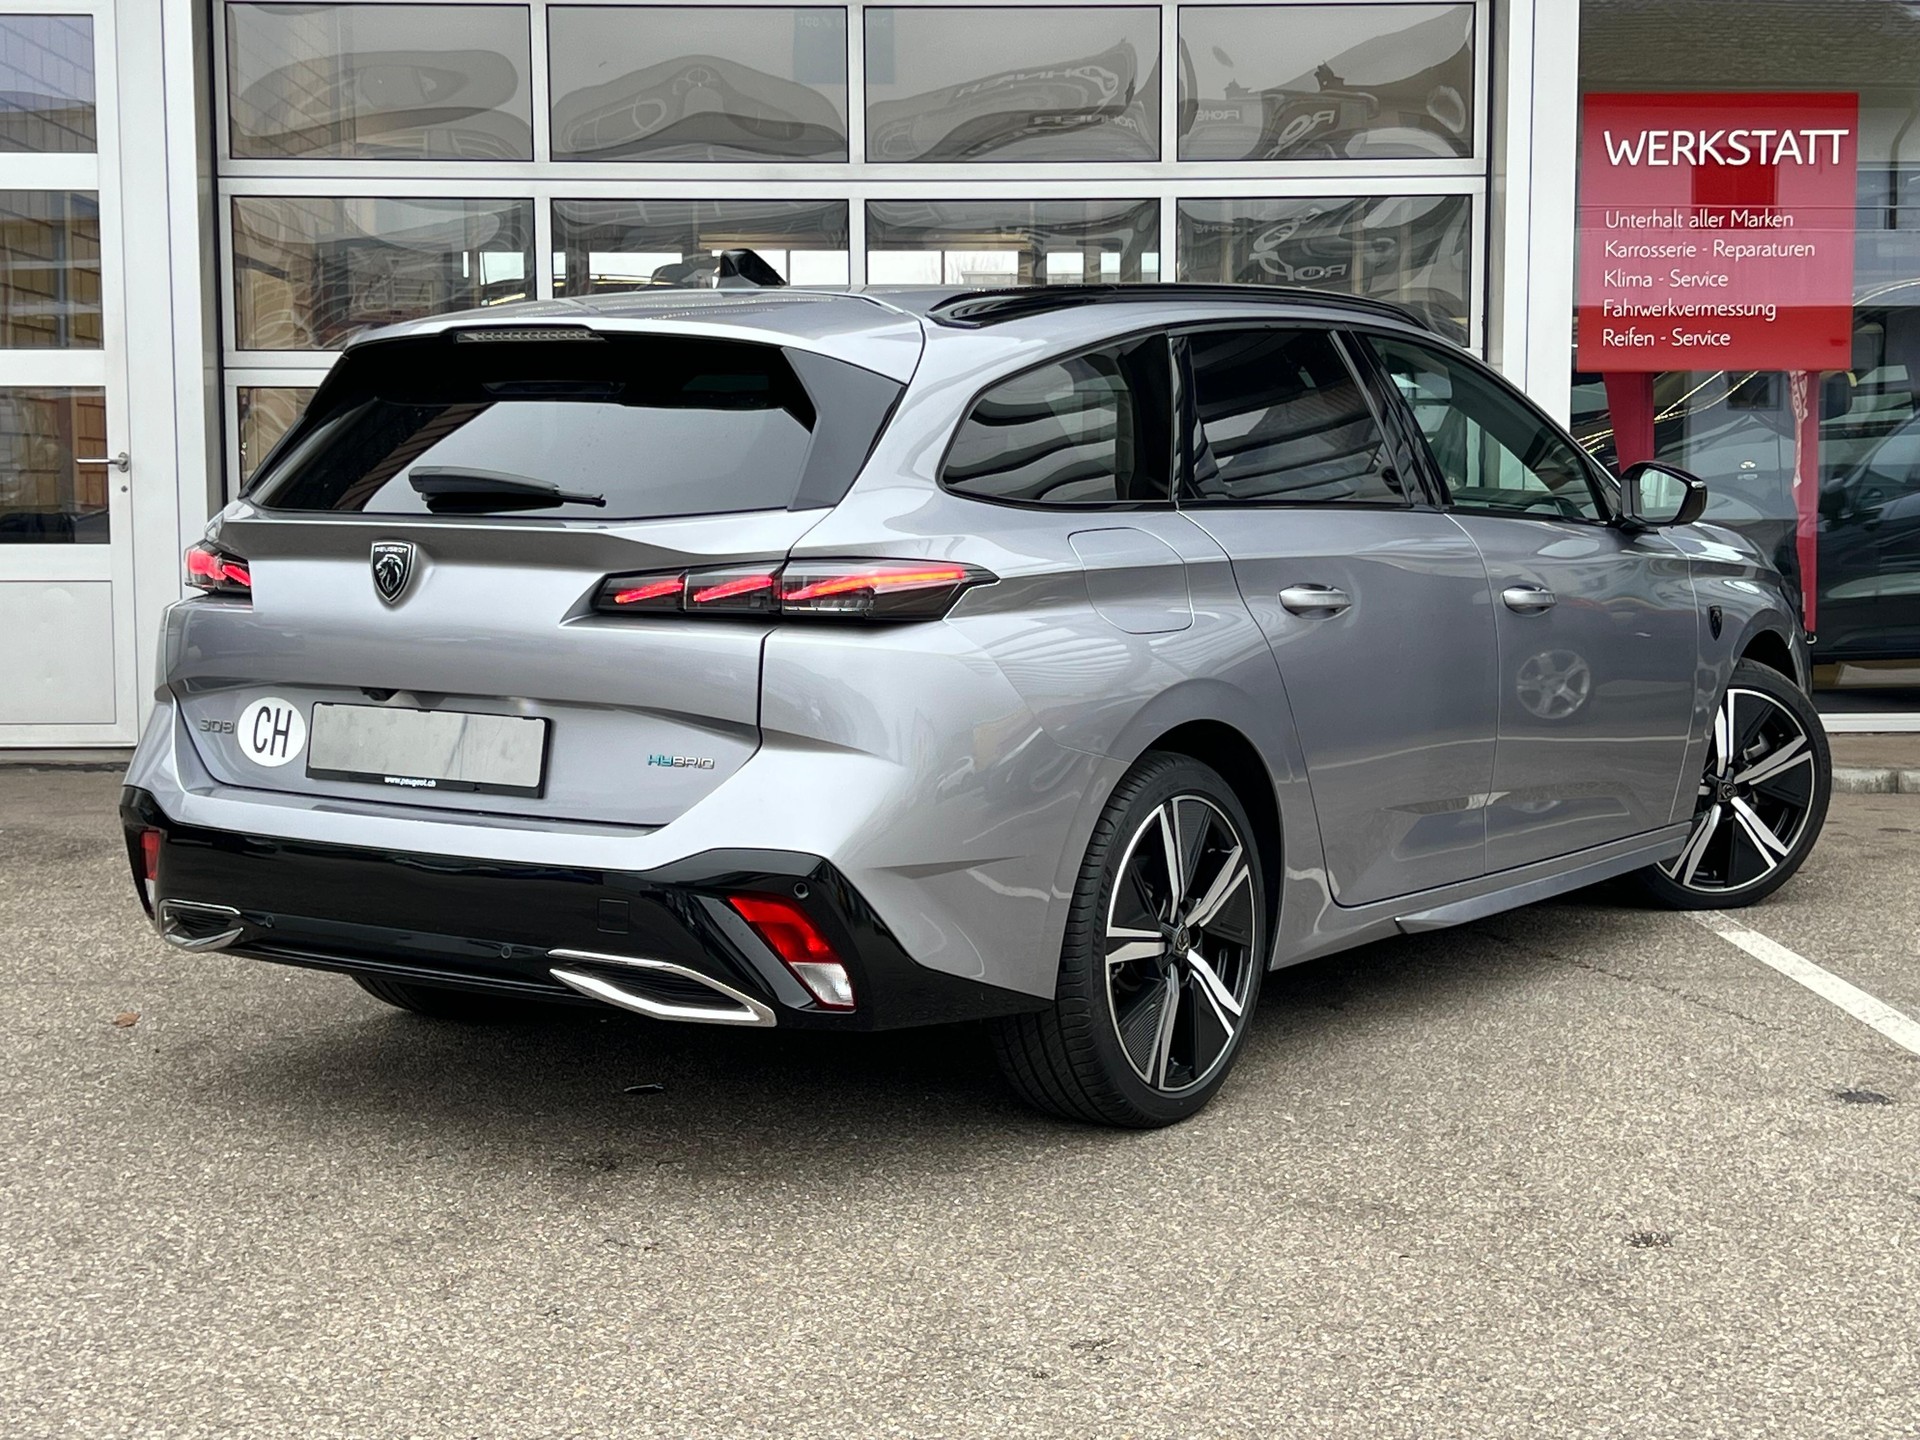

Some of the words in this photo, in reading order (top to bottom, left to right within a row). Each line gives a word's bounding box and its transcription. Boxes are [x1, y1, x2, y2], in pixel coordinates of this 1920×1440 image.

[1603, 129, 1850, 166] WERKSTATT
[1605, 209, 1684, 229] Unterhalt
[1688, 208, 1726, 228] aller
[1730, 208, 1795, 229] Marken
[1604, 239, 1698, 259] Karrosserie
[1713, 239, 1816, 262] Reparaturen
[1603, 268, 1653, 288] Klima
[1669, 268, 1729, 288] Service
[1603, 298, 1777, 321] Fahrwerkvermessung
[1602, 327, 1655, 347] Reifen
[1671, 327, 1731, 347] Service
[199, 718, 235, 734] 308
[253, 706, 293, 758] CH
[648, 754, 715, 770] HYBRID
